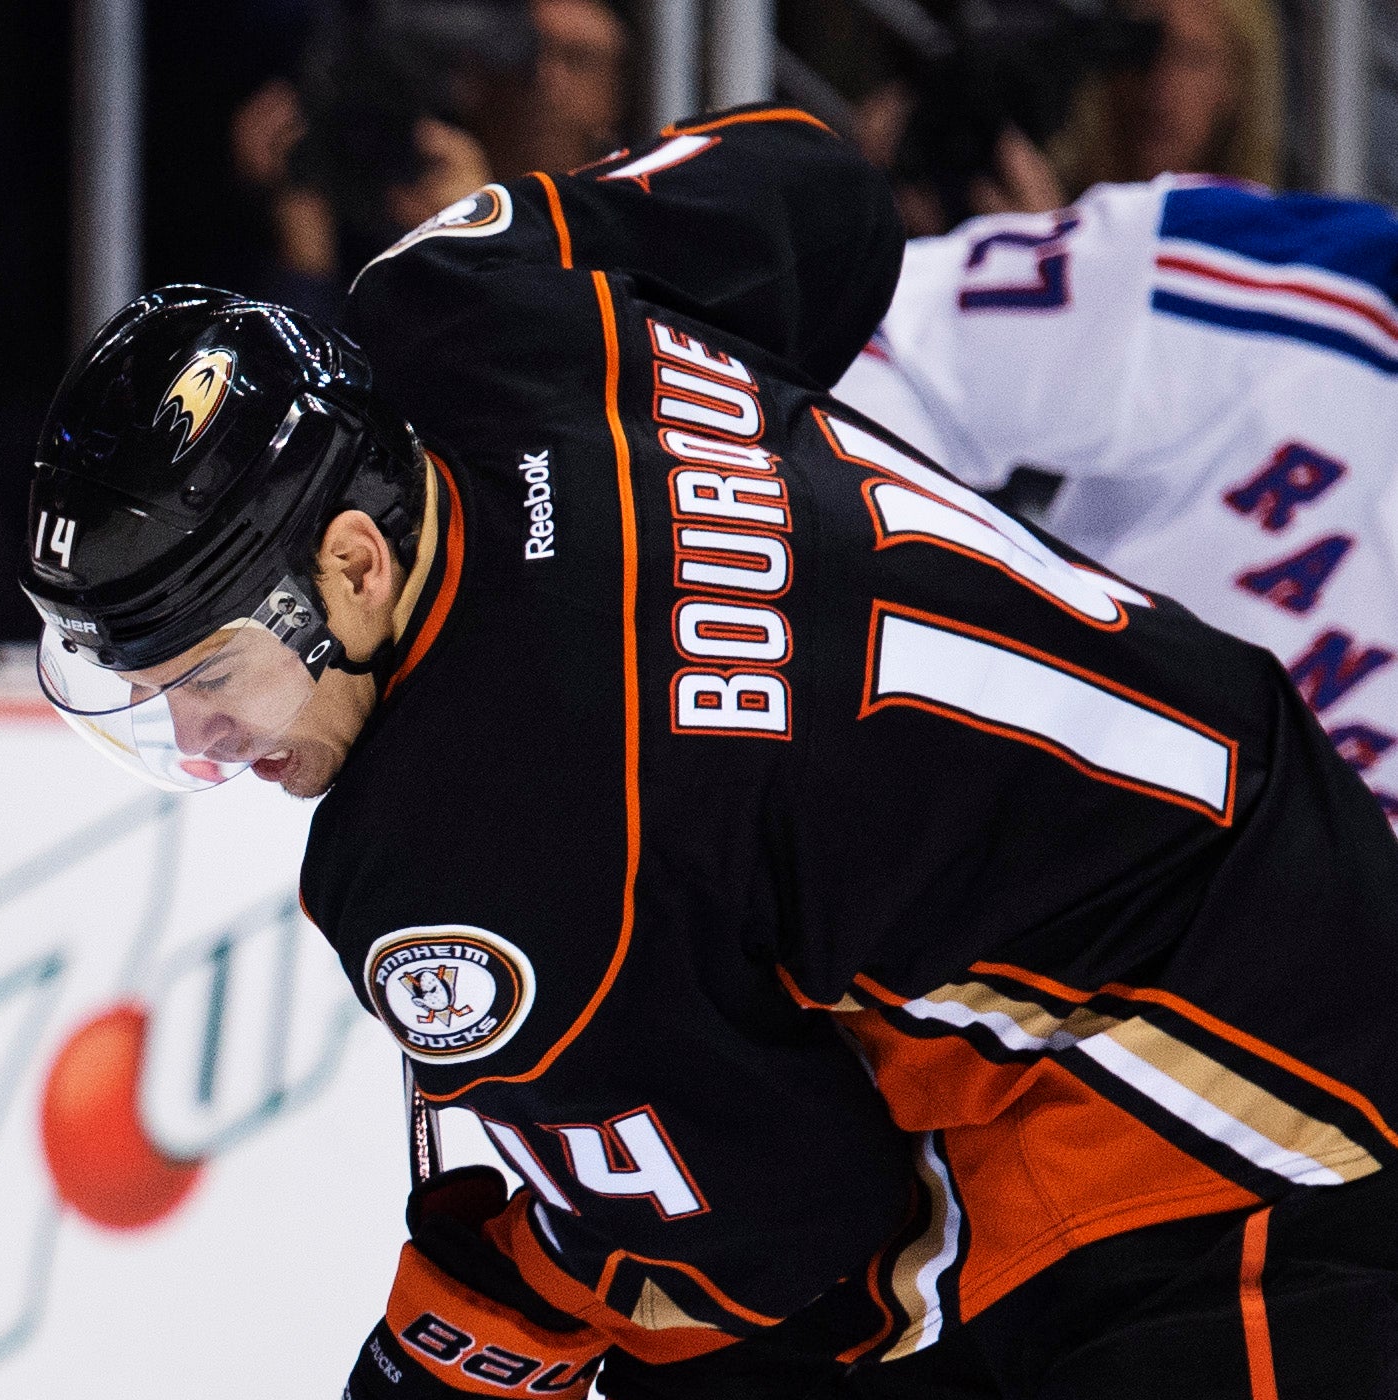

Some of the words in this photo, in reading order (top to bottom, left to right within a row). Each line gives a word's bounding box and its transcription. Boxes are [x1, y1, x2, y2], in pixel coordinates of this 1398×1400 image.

[33, 510, 77, 569] 14
[518, 449, 555, 560] Reebok
[647, 318, 793, 742] BOURQUE
[46, 611, 99, 635] AUER
[1222, 440, 1398, 818] RANG
[375, 944, 491, 987] ANAHEIM
[406, 1014, 499, 1048] DUCKS
[472, 1103, 711, 1221] 14
